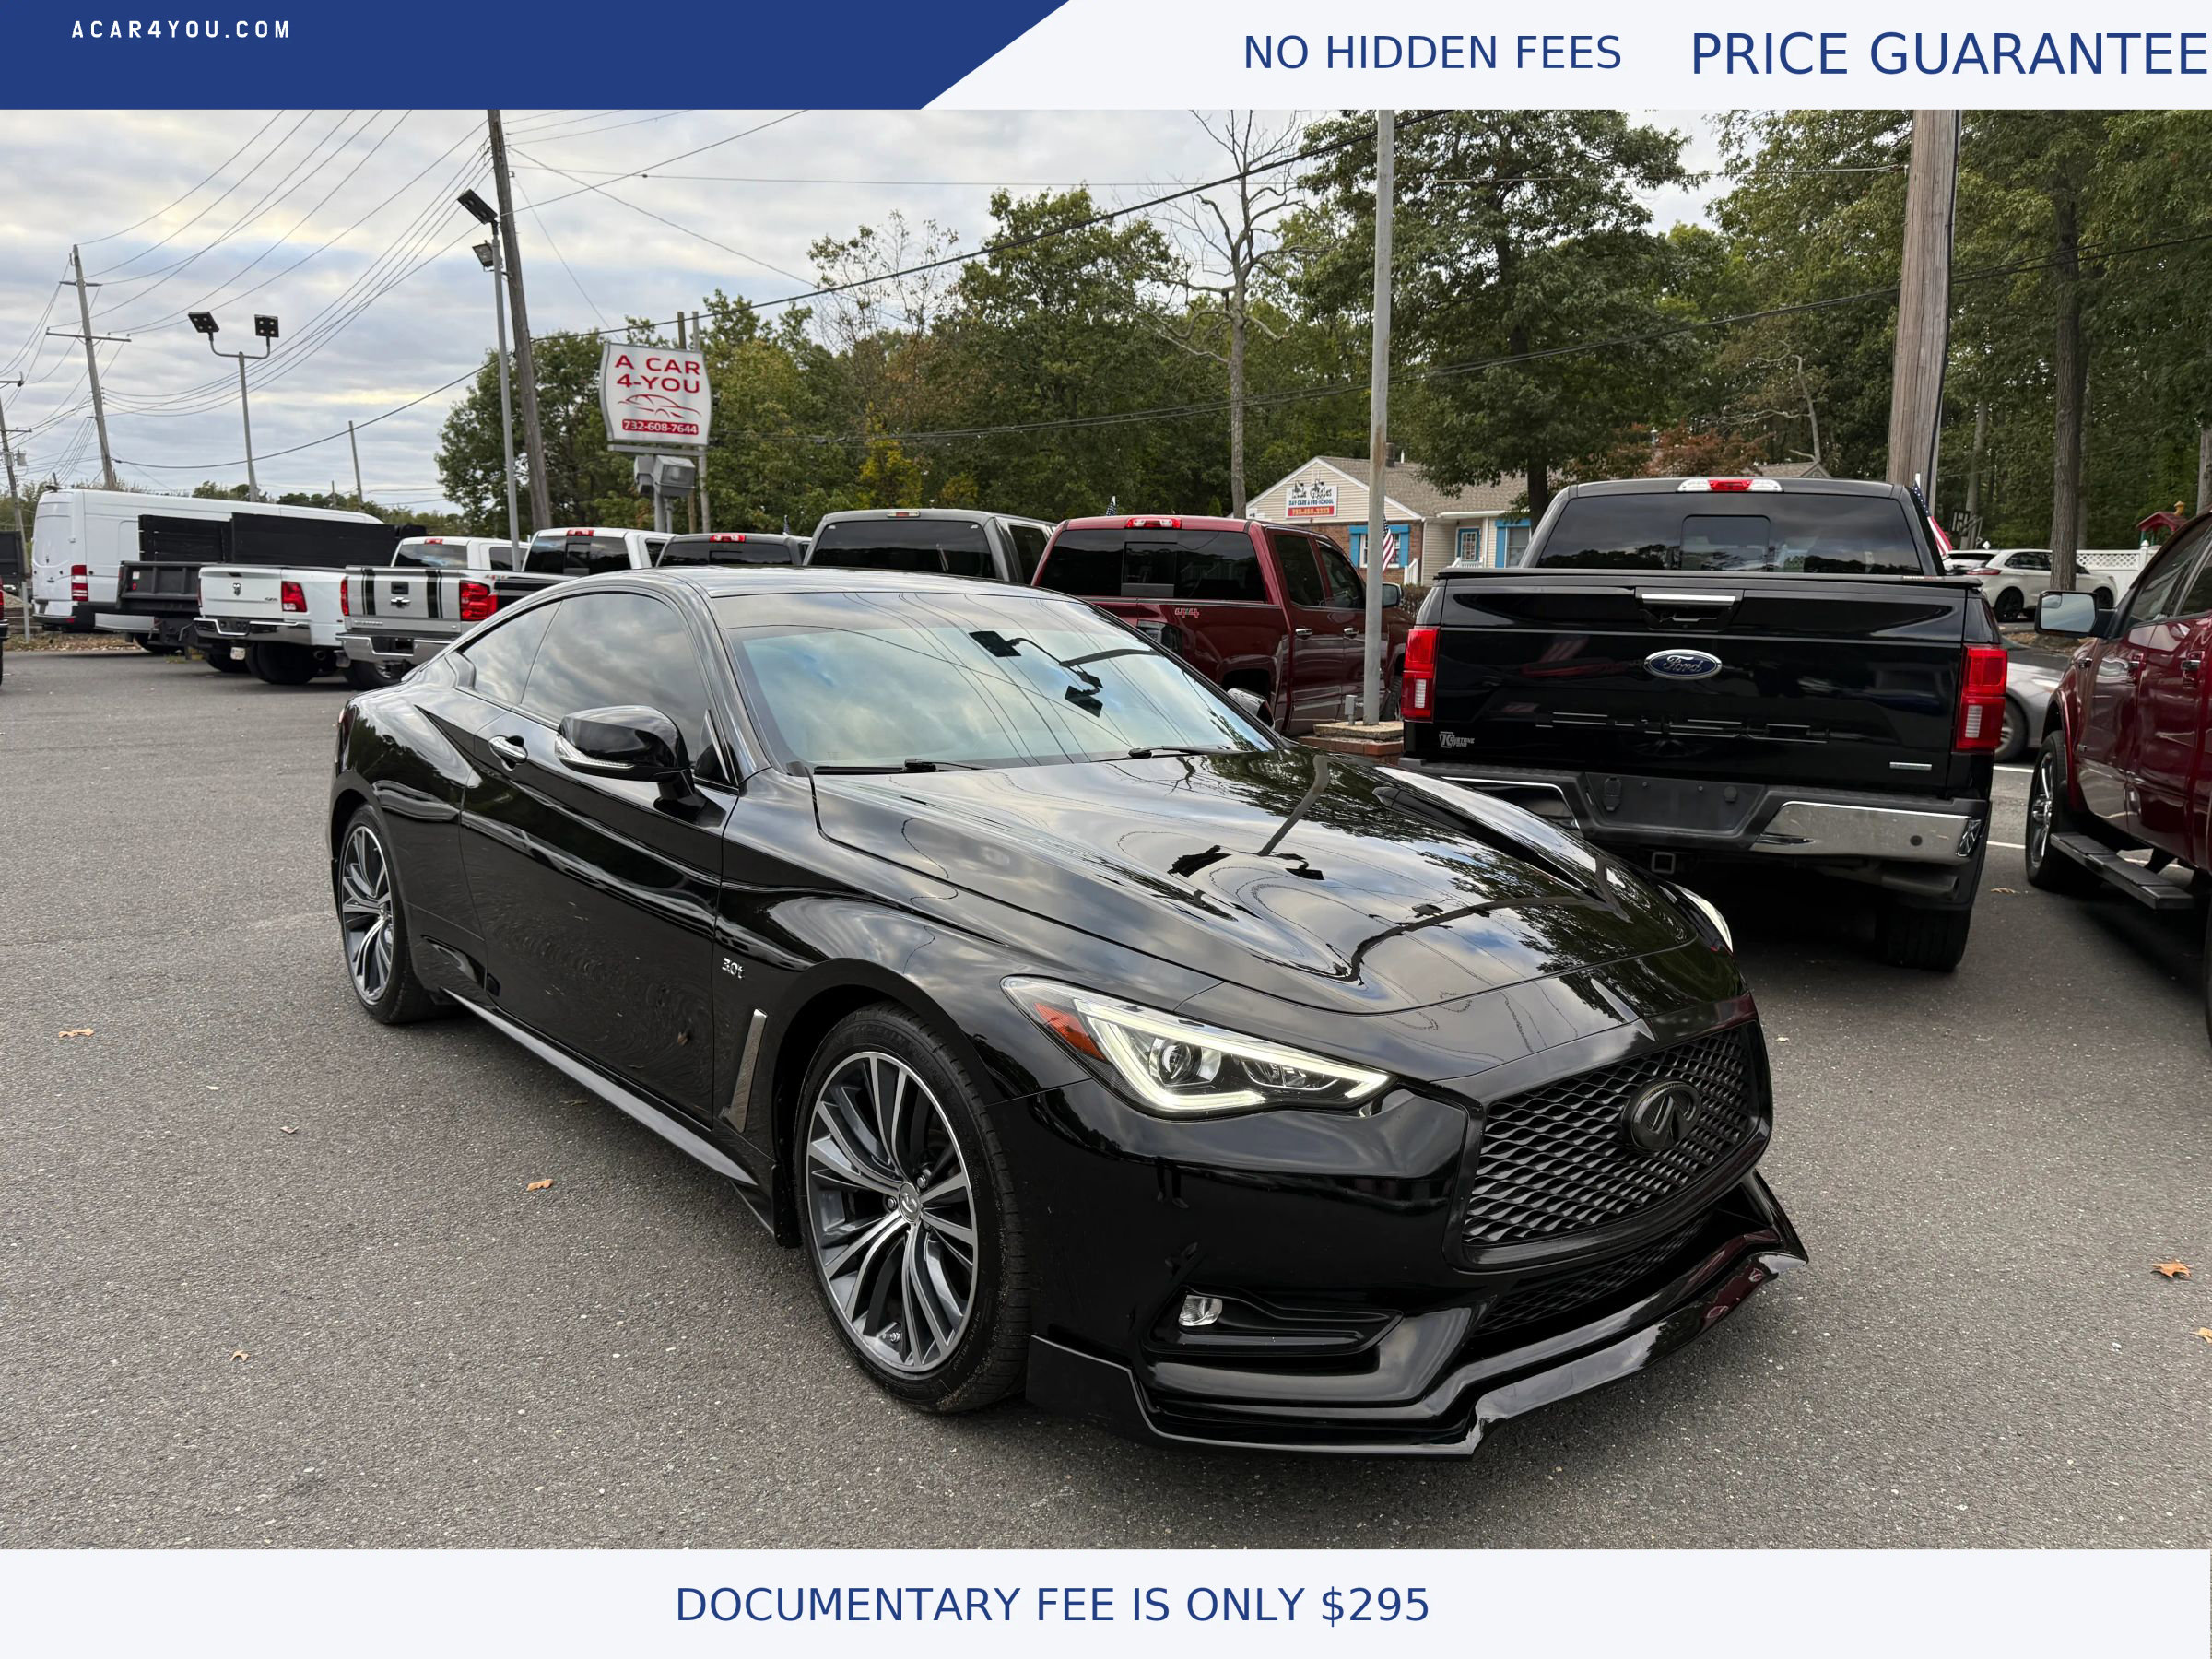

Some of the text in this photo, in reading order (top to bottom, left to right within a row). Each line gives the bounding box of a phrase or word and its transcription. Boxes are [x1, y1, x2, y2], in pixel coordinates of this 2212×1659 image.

[615, 354, 701, 376] A CAR
[616, 373, 700, 394] 4-YOU
[623, 419, 699, 435] 732-608-7644
[1663, 654, 1704, 673] Ford
